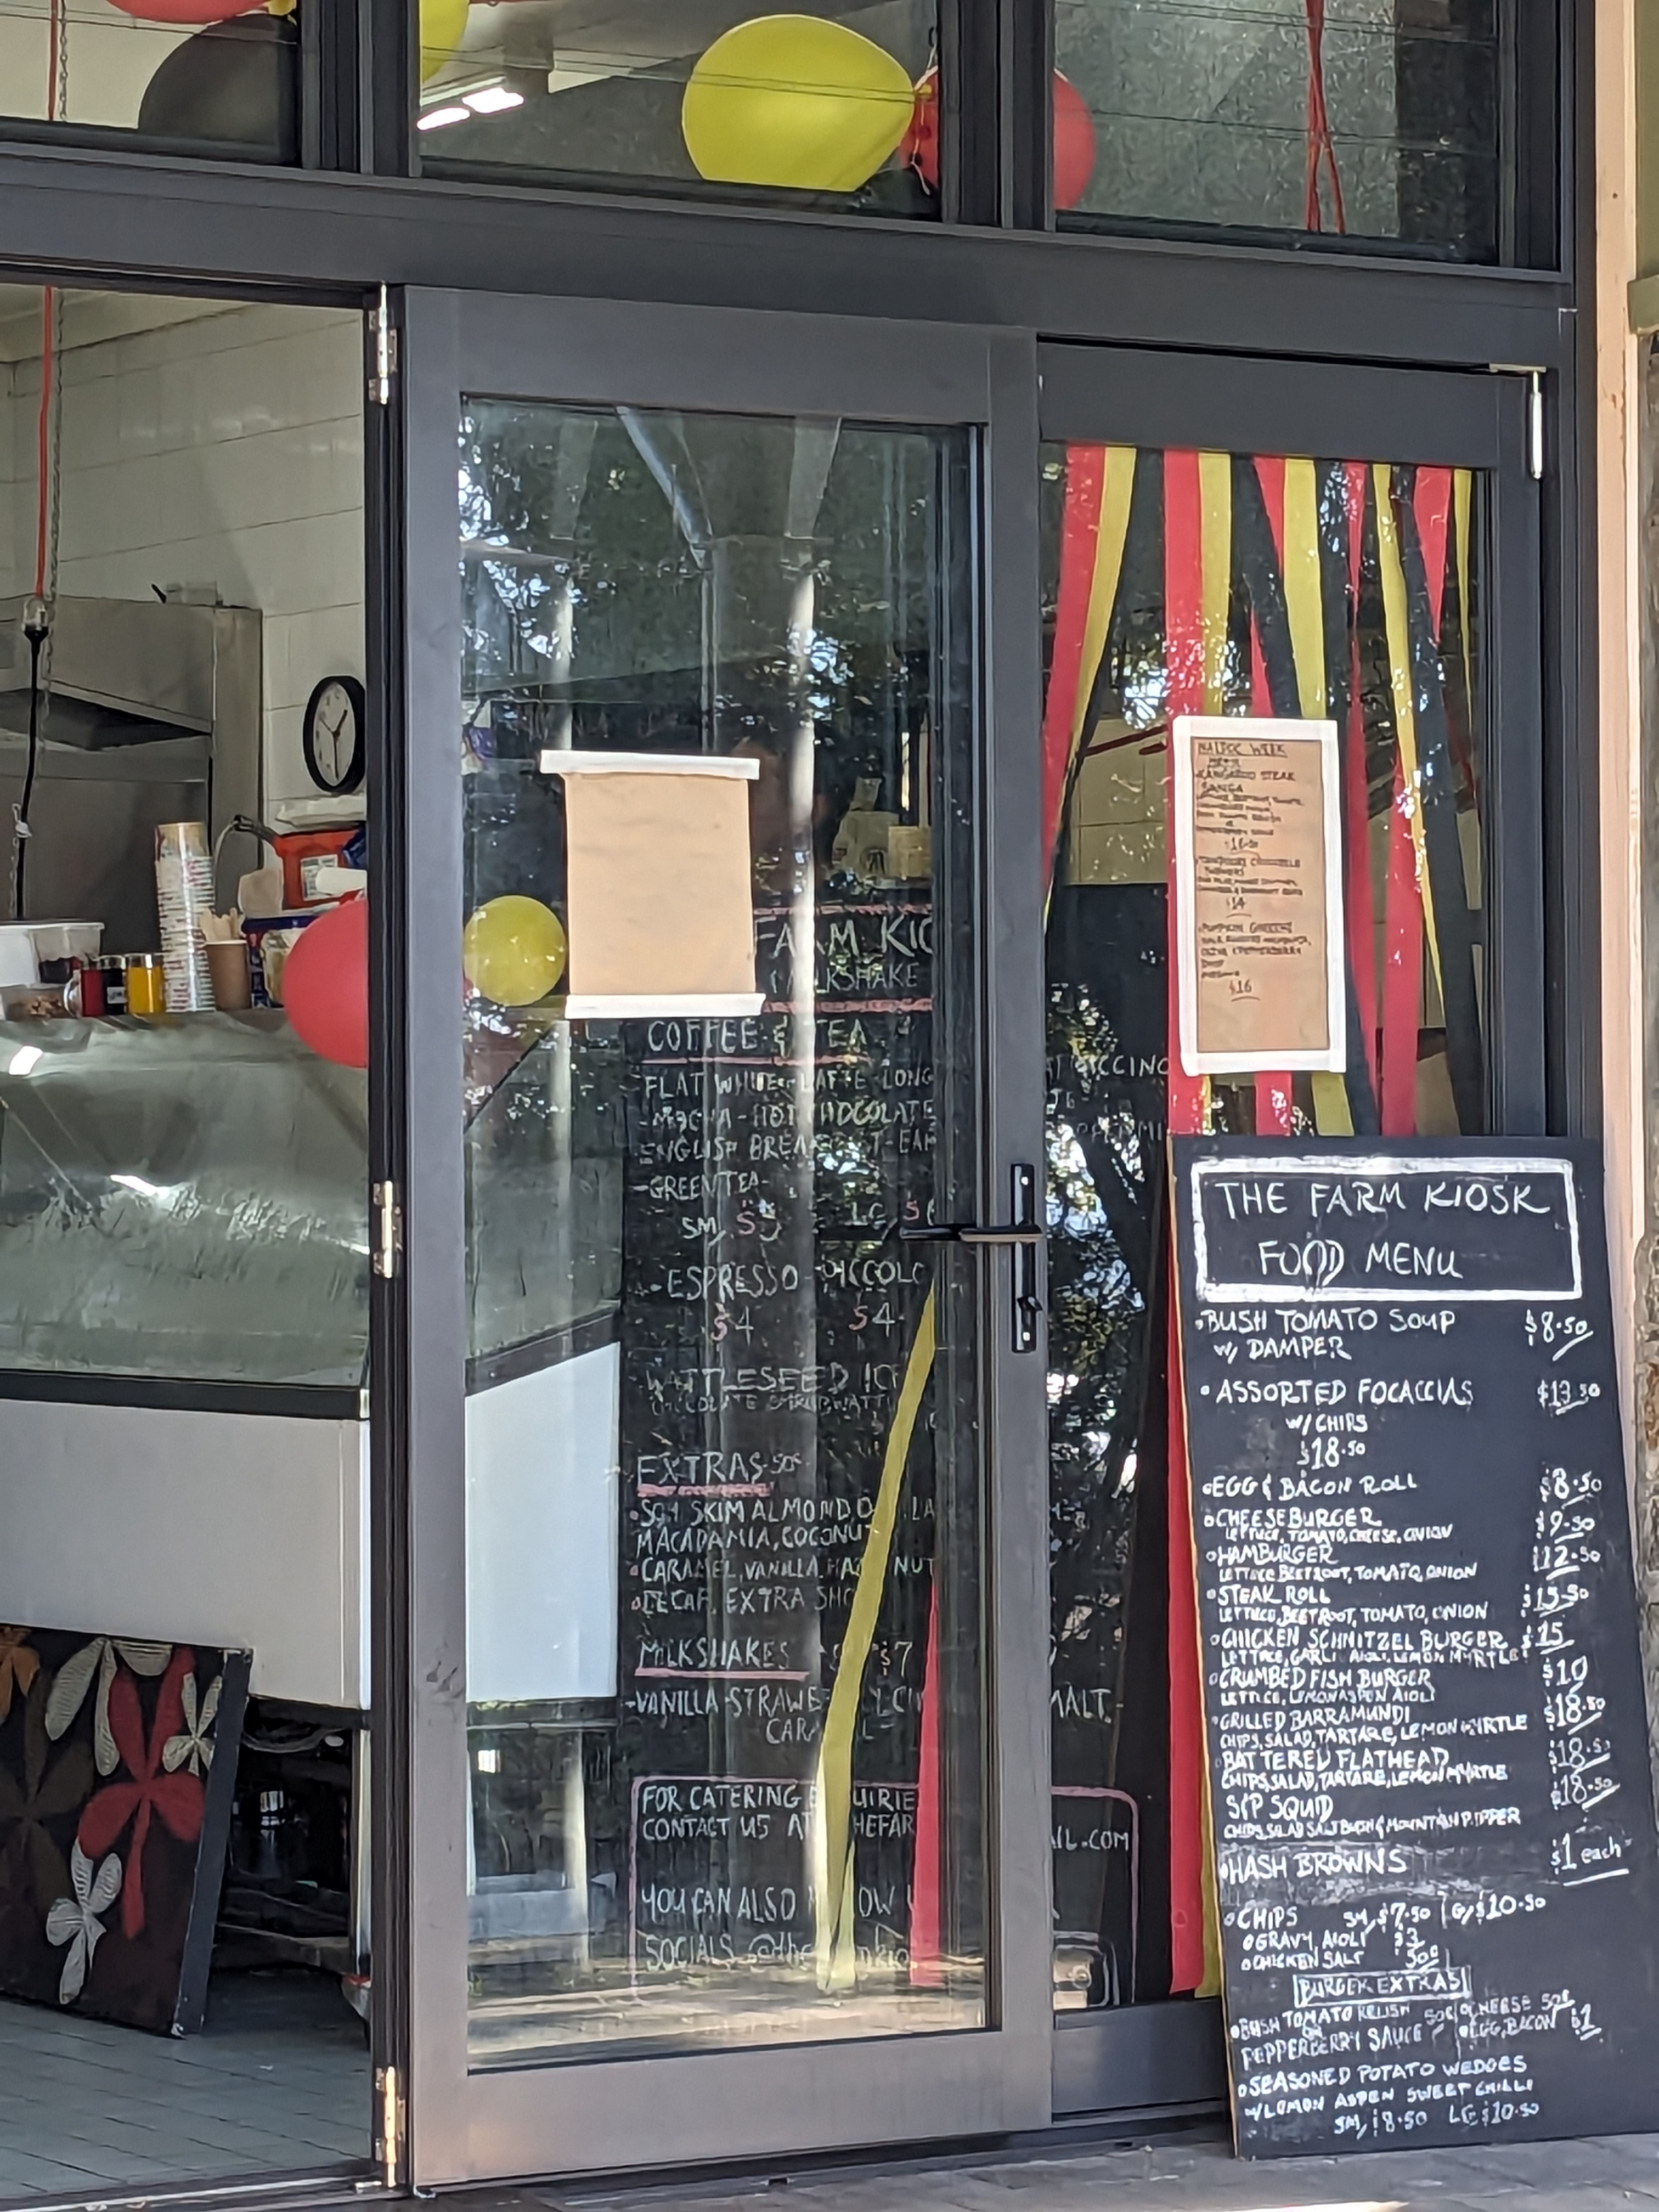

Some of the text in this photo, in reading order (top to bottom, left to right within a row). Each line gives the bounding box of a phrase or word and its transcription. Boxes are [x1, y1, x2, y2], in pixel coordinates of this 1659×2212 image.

[754, 917, 860, 958] FAM
[648, 1018, 758, 1053] COFFEE
[644, 1071, 705, 1099] FLAT
[1215, 1182, 1551, 1219] THE FARM KIOSK
[1259, 1239, 1463, 1286] FOOD MENU
[668, 1263, 798, 1302] ESPRESSO
[1205, 1310, 1268, 1334] BUSH
[1274, 1308, 1378, 1333] TOMATO
[1524, 1309, 1588, 1346] $8.50
[1248, 1336, 1352, 1361] DAMPER
[1216, 1379, 1347, 1404] ASSORTED
[1358, 1378, 1473, 1406] FOCACCIAS
[1212, 1475, 1259, 1498] EGG
[1278, 1476, 1352, 1502] BACON
[1359, 1473, 1418, 1495] ROLL
[1540, 1467, 1602, 1502] $8.50
[691, 1499, 744, 1526] SKIM
[1217, 1543, 1340, 1567] HAMBURGER
[1424, 1562, 1477, 1581] ONION
[726, 1586, 805, 1615] EXTRA
[1217, 1583, 1283, 1606] STEAK
[1285, 1585, 1331, 1605] ROLL
[1432, 1600, 1488, 1621] ONION
[639, 1636, 790, 1671] MILKSHAKES
[1221, 1626, 1300, 1649] CHICKEN
[1307, 1627, 1414, 1652] SCHNITZEL
[1419, 1629, 1509, 1652] BURGER
[1219, 1655, 1589, 1691] CRUMBED FISH BURGER $10
[1220, 1711, 1286, 1733] GRILLED
[1289, 1703, 1410, 1732] BARRAMUNDI
[1221, 1748, 1331, 1773] BATTERED
[1335, 1745, 1450, 1772] FLATHEAD
[642, 1784, 802, 1813] FOR CATERING
[1268, 1793, 1334, 1824] SQUID
[642, 1816, 731, 1841] CONTACT
[740, 1814, 770, 1839] US
[1228, 1854, 1288, 1885] HASH
[1292, 1847, 1408, 1878] BROWNS
[1580, 1836, 1622, 1864] each
[641, 1882, 686, 1923] YOU
[736, 1886, 797, 1923] ALSO
[1237, 1906, 1299, 1930] CHIPS
[1322, 1950, 1365, 1969] SALT
[1282, 2006, 1353, 2029] TOMATO
[1249, 2067, 1351, 2096] SEASONED
[1356, 2061, 1436, 2084] POTATO
[1407, 2083, 1472, 2103] SWEET
[1475, 2078, 1534, 2096] CHILLI
